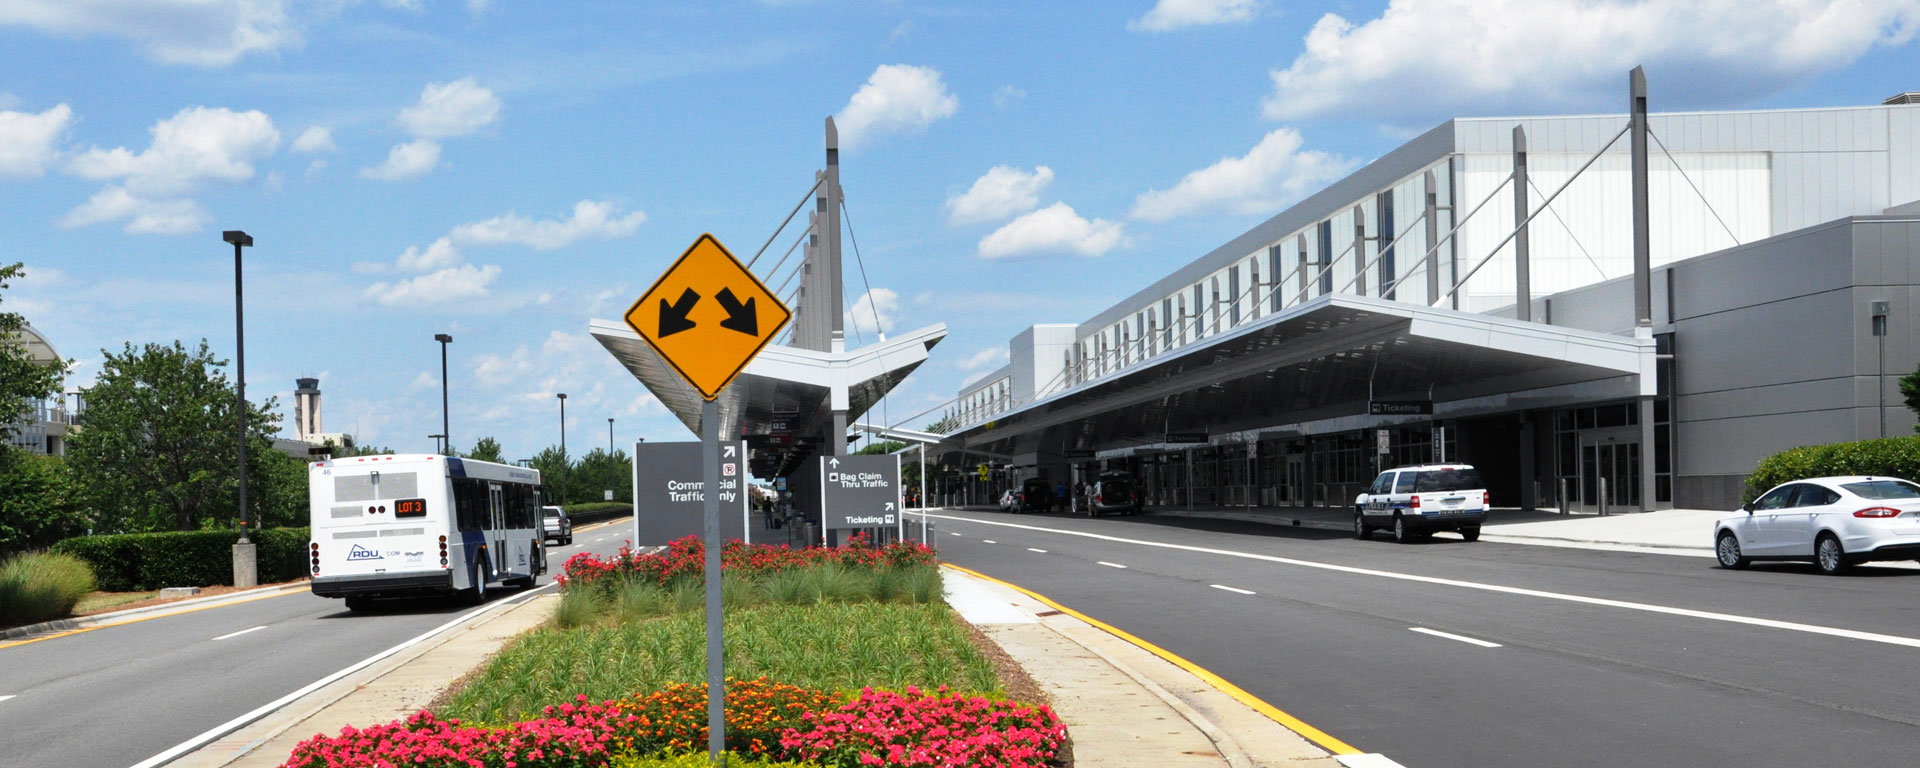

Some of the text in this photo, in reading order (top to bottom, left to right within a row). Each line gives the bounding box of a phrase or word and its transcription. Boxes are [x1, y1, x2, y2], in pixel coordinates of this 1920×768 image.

[1383, 403, 1420, 412] Ticketing
[840, 472, 882, 481] Bag Claim
[668, 479, 736, 490] Commcial
[669, 491, 736, 502] Traffic nly
[398, 502, 422, 513] LOT 3
[845, 515, 883, 524] Ticketing
